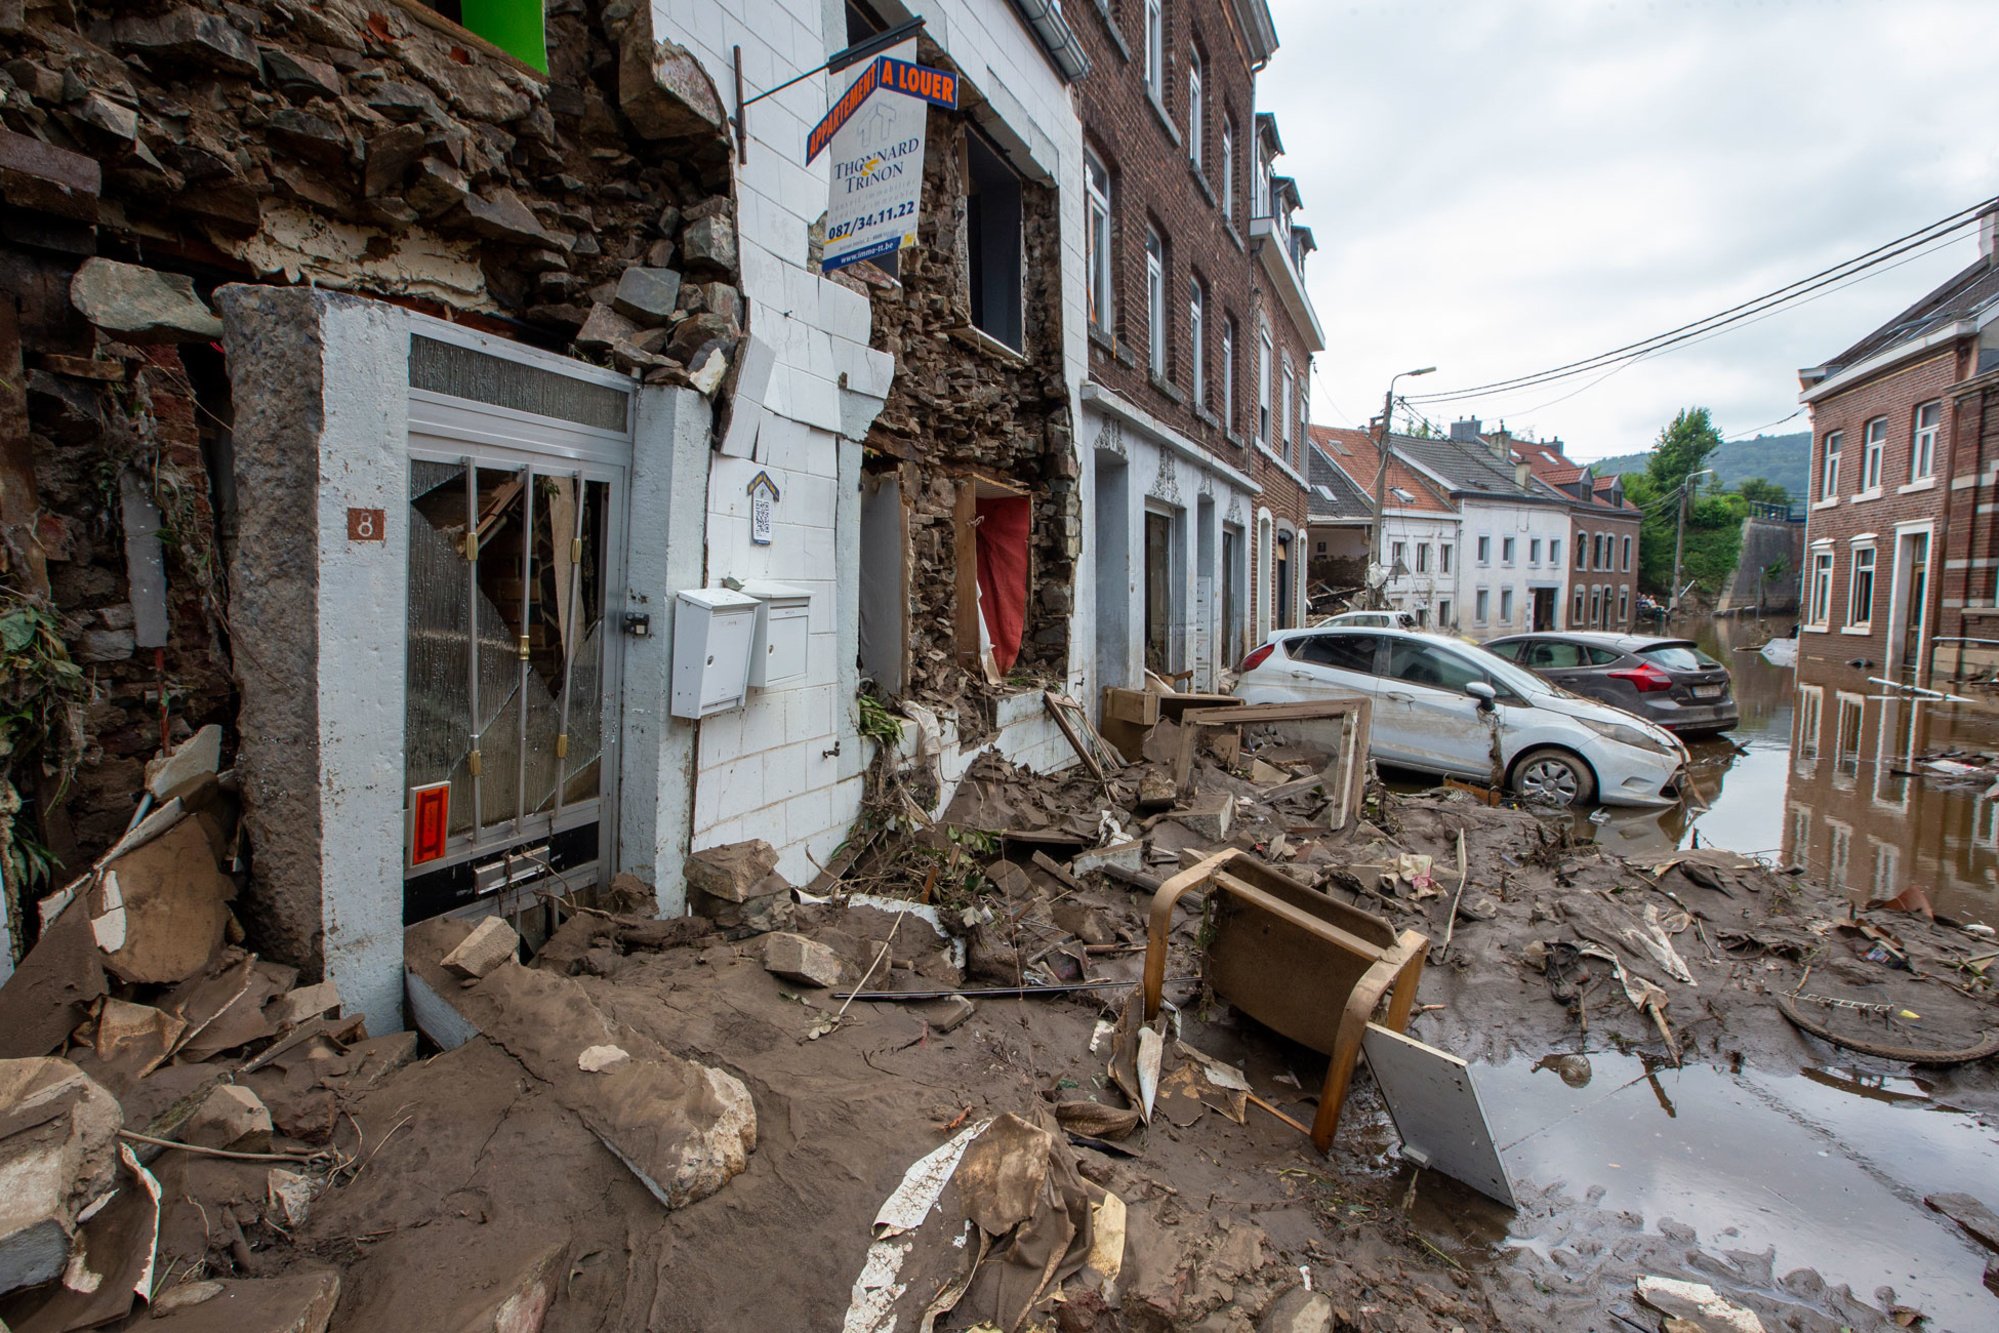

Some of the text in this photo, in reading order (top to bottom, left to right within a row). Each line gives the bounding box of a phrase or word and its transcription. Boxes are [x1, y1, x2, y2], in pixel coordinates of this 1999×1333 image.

[881, 60, 954, 103] A LOUER
[809, 63, 877, 157] APPARTEMENT
[845, 161, 904, 194] TRINON
[828, 200, 915, 240] 087/34.11.22
[357, 512, 373, 537] 8
